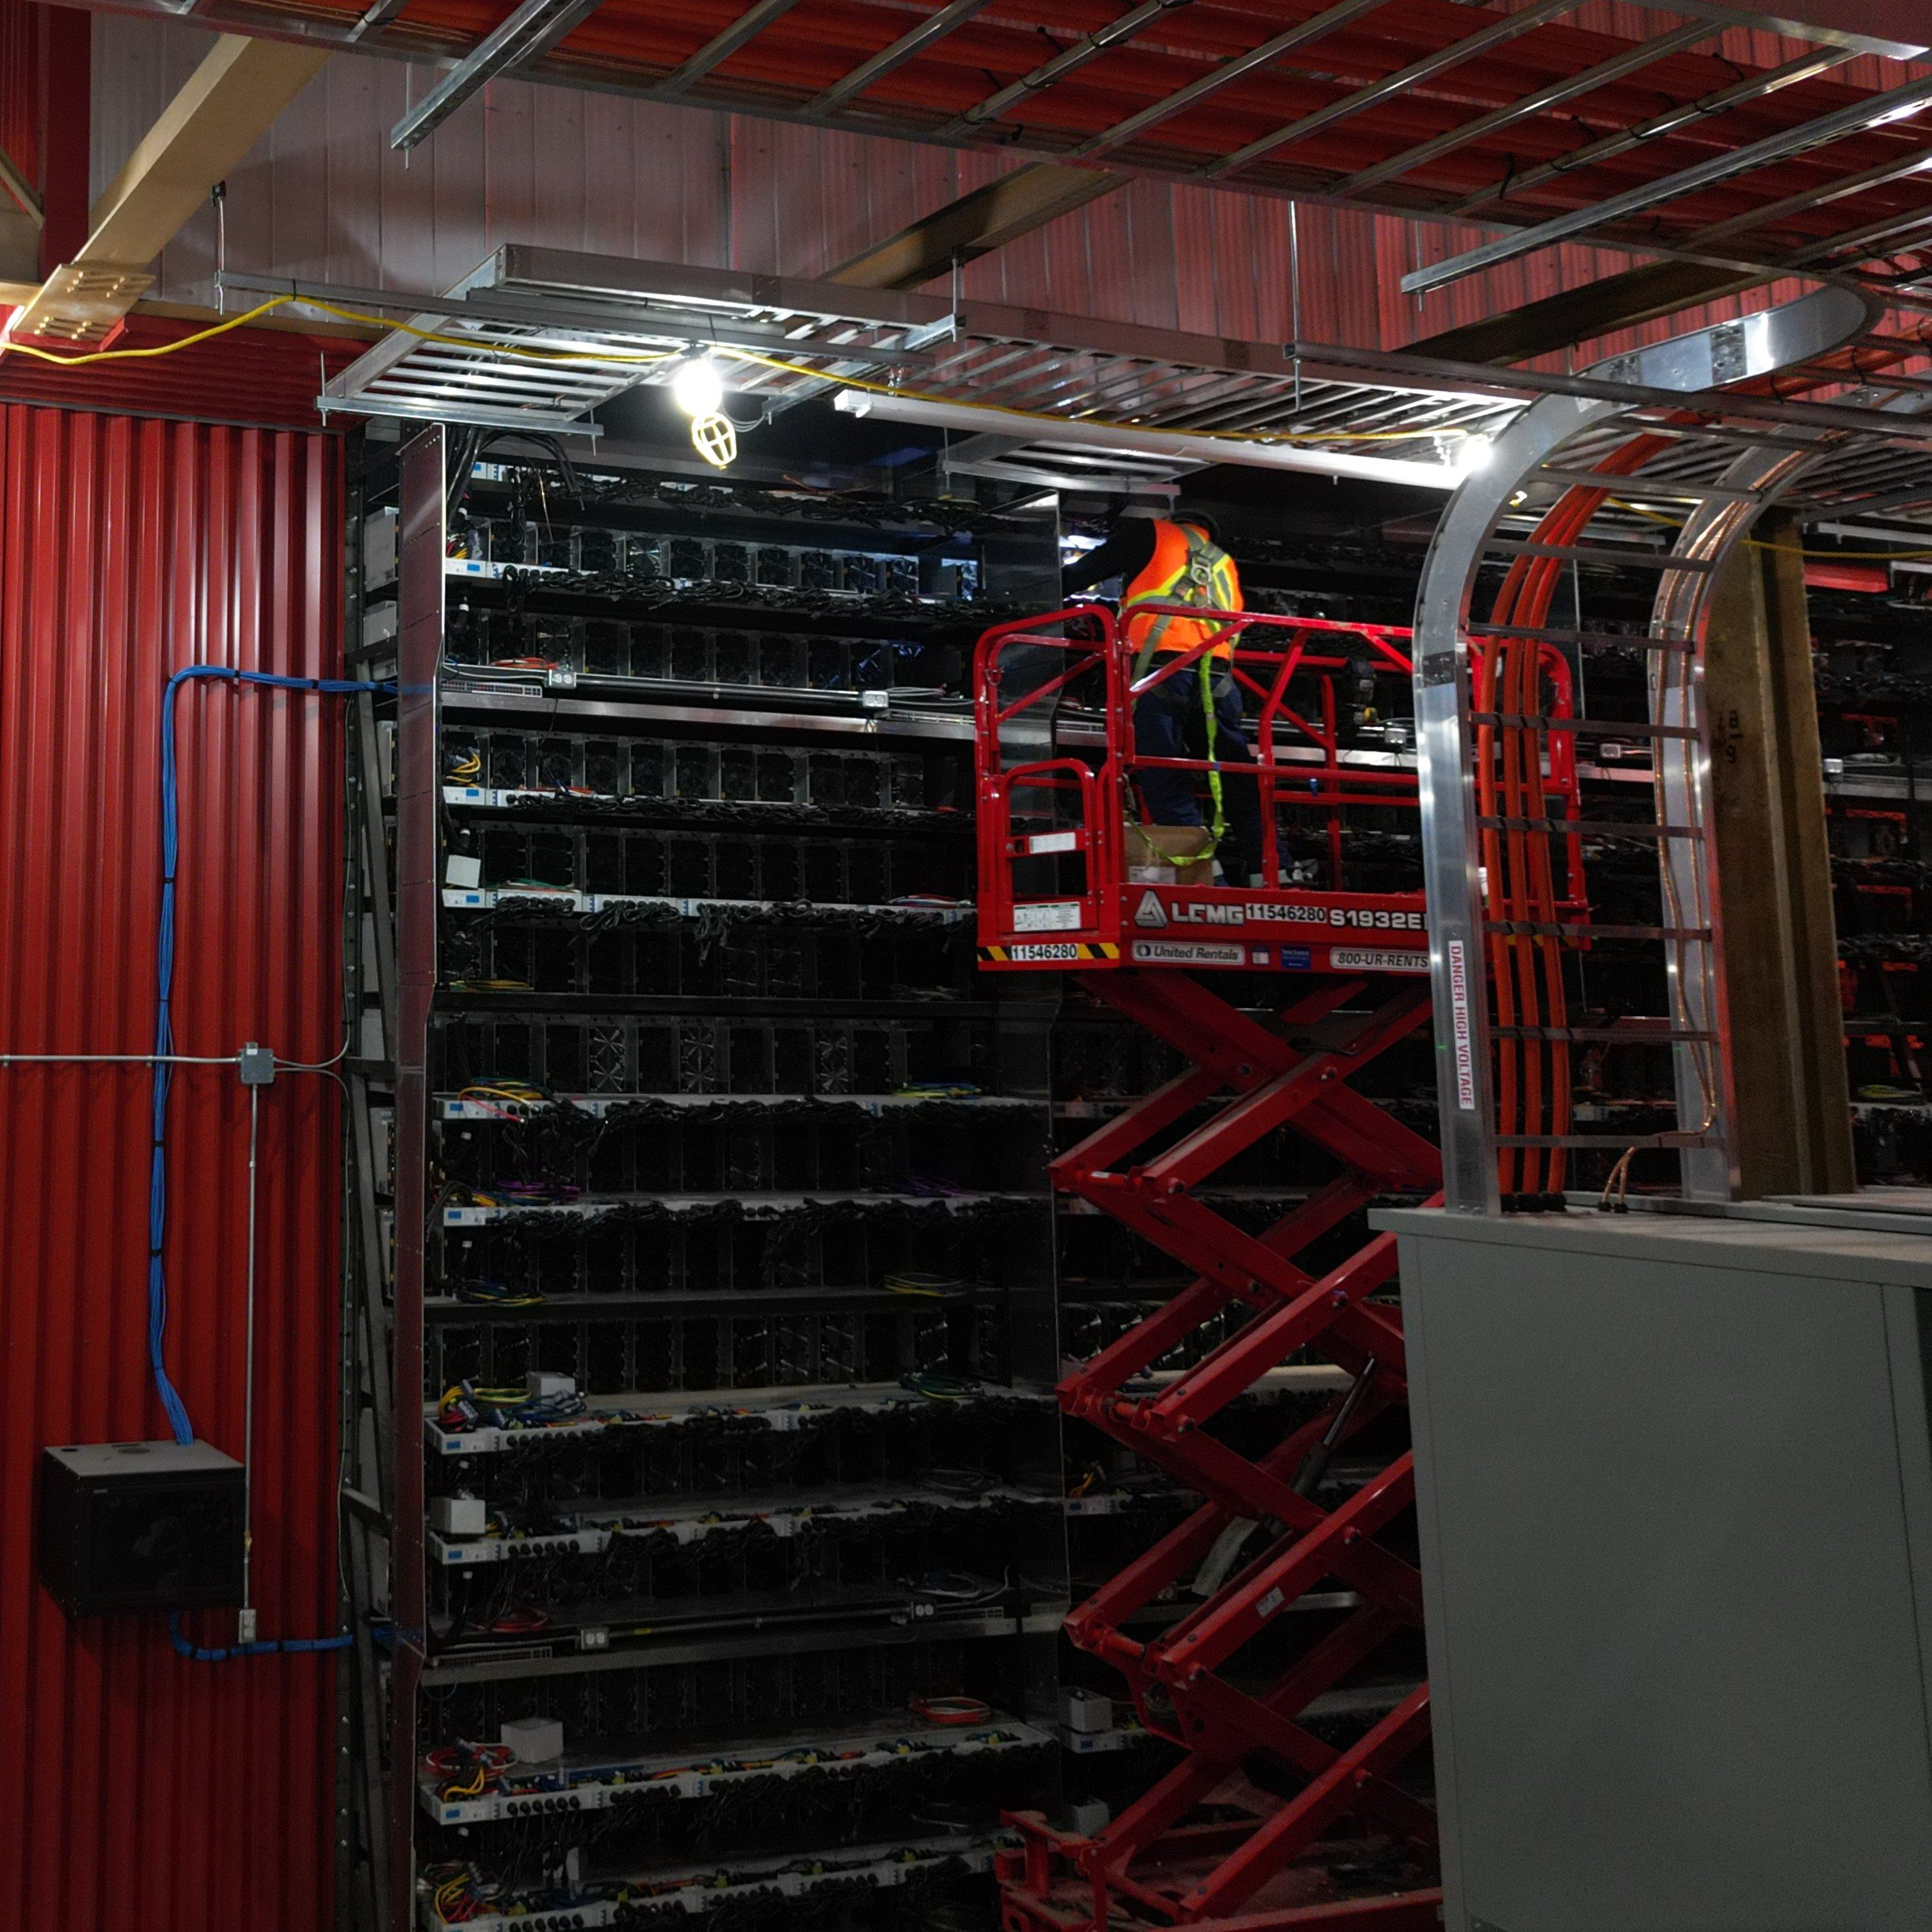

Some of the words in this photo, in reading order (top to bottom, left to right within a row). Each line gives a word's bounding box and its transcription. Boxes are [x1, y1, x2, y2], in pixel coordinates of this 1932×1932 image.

[1247, 903, 1325, 922] 11546280
[1013, 943, 1078, 960] 11546280
[1154, 945, 1194, 958] United
[1196, 947, 1239, 961] Rentals
[1338, 952, 1428, 968] 800-UR-RENTS
[1450, 945, 1465, 1002] DANGER
[1454, 1006, 1467, 1041] HIGH
[1458, 1045, 1472, 1105] VOLTAGE
